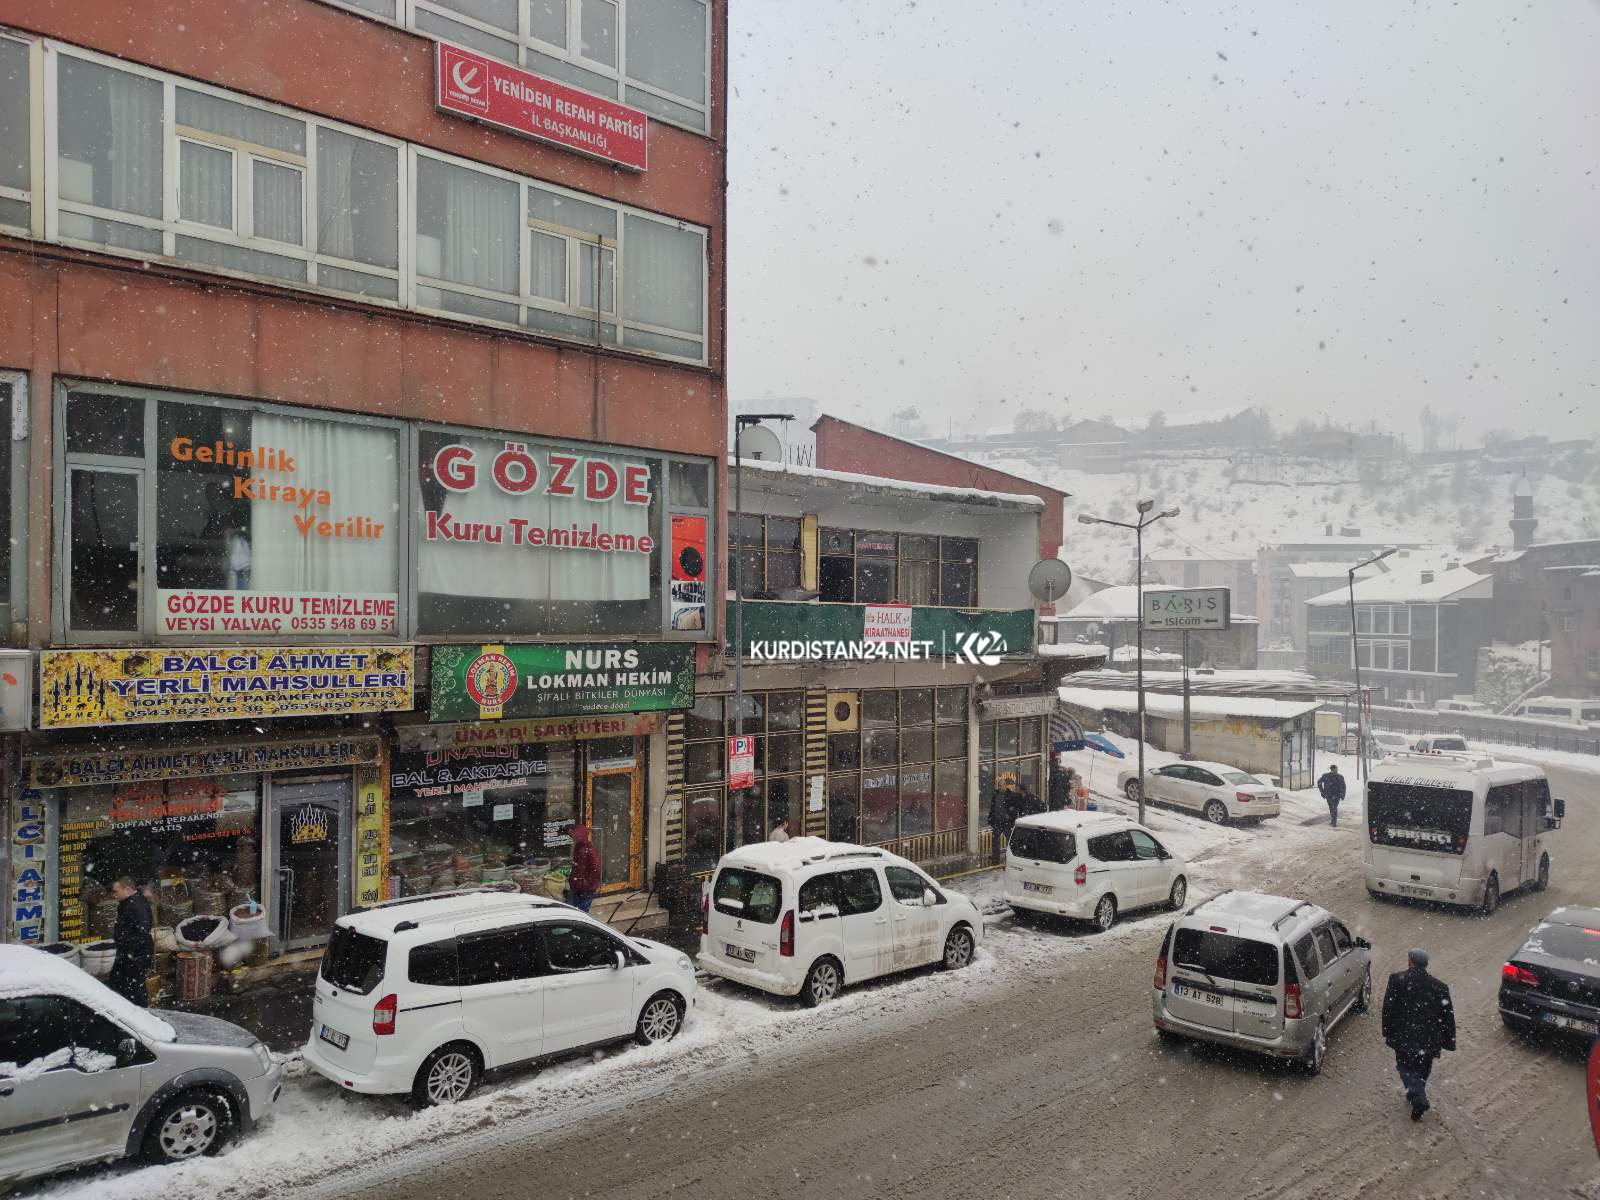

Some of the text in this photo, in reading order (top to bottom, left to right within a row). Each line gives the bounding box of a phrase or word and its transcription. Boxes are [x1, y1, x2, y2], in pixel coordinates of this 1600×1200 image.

[493, 76, 643, 141] YENİDEN REFAH PARTİSİ
[532, 110, 608, 149] İL BAŞKANLIĞI
[170, 436, 297, 473] Gelinlik
[434, 441, 653, 506] GÖZDE
[232, 475, 332, 509] Kiraya
[293, 513, 385, 539] Verilir
[426, 511, 655, 554] Kuru Temizleme
[167, 591, 396, 617] GÖZDE KURU TEMİZLEME
[166, 615, 396, 635] VEYSİ YALVAÇ 0535 548 69 51
[876, 611, 903, 625] HALK
[163, 654, 369, 673] BALCI AHMET
[565, 649, 639, 670] NURS
[110, 670, 407, 696] YERLİ MAHSULLERİ
[527, 667, 672, 690] LOKMAN HEKİM
[130, 698, 206, 708] TOPTAN
[575, 689, 619, 700] BİTKİLER
[624, 687, 666, 698] DÜNYASI
[131, 753, 193, 770] AHMET
[391, 769, 434, 788] BAL
[438, 769, 452, 782] &
[457, 759, 547, 782] AKTARİYE
[110, 819, 152, 830] TOPTAN
[1180, 986, 1189, 996] 13
